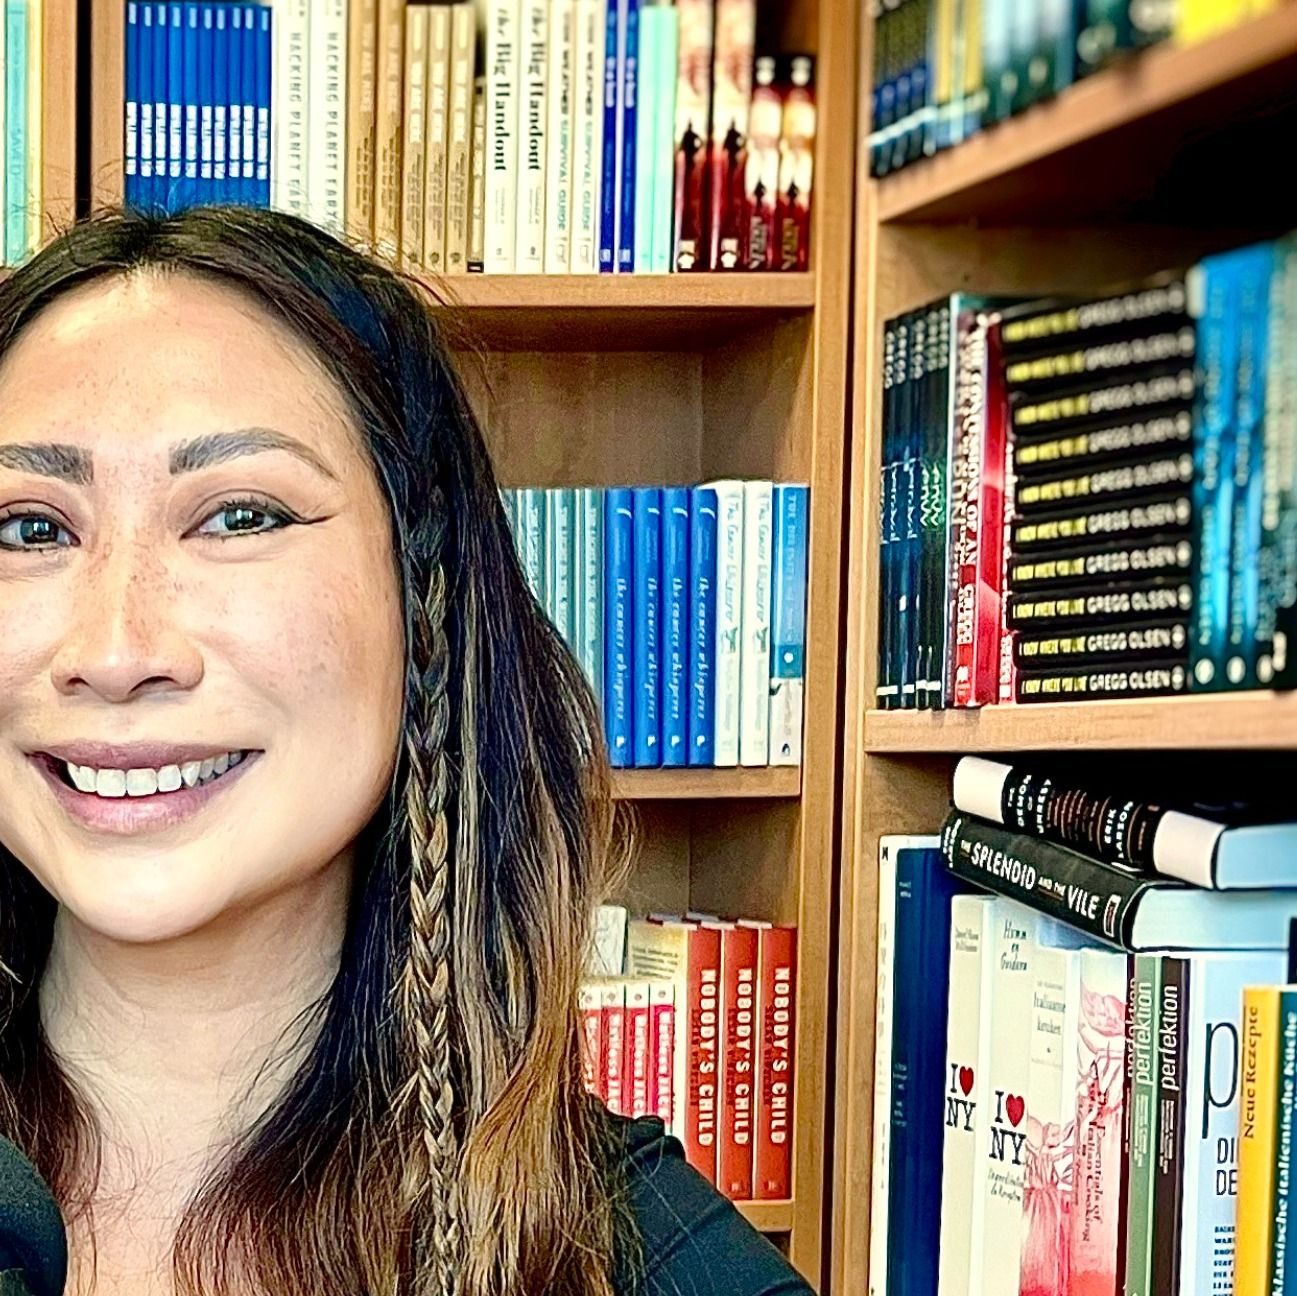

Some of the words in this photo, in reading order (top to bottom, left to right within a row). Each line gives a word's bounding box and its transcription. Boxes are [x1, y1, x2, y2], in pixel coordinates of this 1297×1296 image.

[290, 32, 301, 102] HACKING
[326, 32, 338, 102] HACKING
[1087, 632, 1127, 652] GREGG
[1128, 628, 1171, 649] OLSEN
[1089, 673, 1128, 692] GREGG
[1129, 669, 1171, 690] OLSEN
[1104, 808, 1117, 844] ERIK
[1117, 800, 1134, 859] LARSON
[970, 842, 1036, 891] SPLENDID
[1066, 884, 1101, 920] VILE
[699, 969, 717, 1074] NOBODY'S
[735, 968, 753, 1073] NOBODY'S
[772, 966, 791, 1072] NOBODY'S
[1134, 981, 1154, 1086] perfektion
[1158, 986, 1180, 1091] perfektion
[1246, 1006, 1262, 1084] Rezepte
[950, 1063, 958, 1093] I
[995, 1090, 1004, 1124] I
[697, 1084, 714, 1146] CHILD
[733, 1083, 750, 1145] CHILD
[770, 1082, 787, 1144] CHILD
[946, 1096, 976, 1132] NY
[1244, 1090, 1256, 1139] Neue
[989, 1126, 1027, 1165] NY
